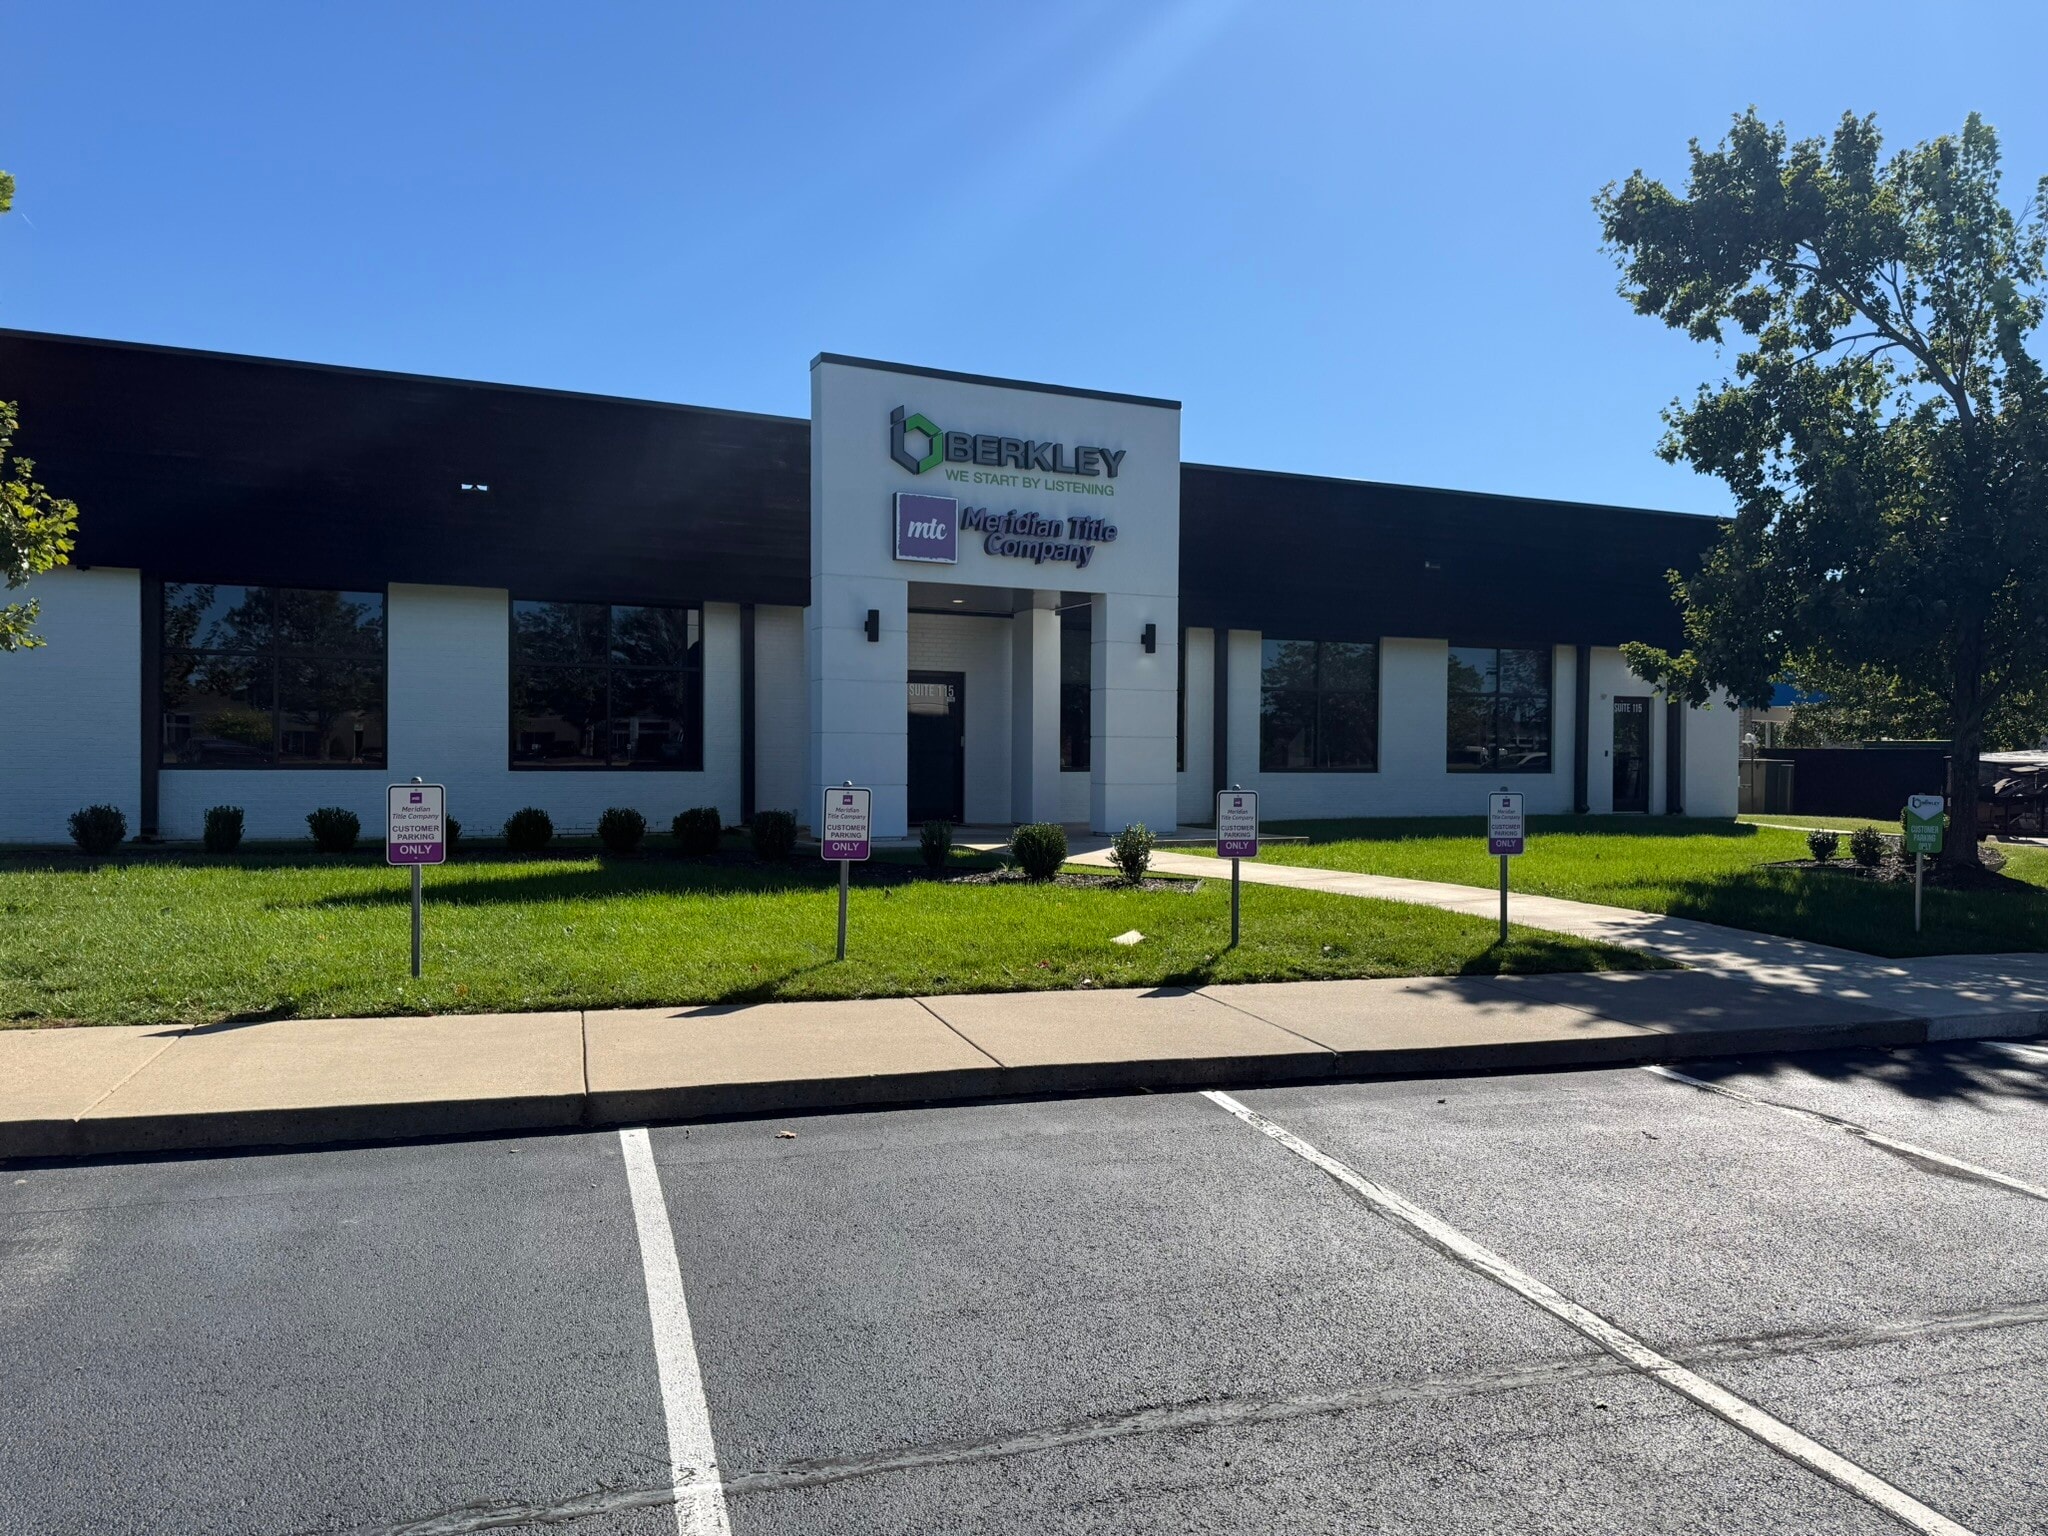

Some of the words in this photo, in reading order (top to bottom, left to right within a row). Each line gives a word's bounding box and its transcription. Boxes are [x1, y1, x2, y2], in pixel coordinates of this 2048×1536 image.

[945, 430, 1126, 478] BERKLEY
[945, 469, 969, 482] WE
[973, 473, 1017, 488] START
[1022, 476, 1041, 489] BY
[1044, 480, 1114, 496] LISTENING
[960, 506, 1063, 538] Meridian
[1067, 516, 1118, 543] Title
[907, 518, 947, 541] mtc
[984, 534, 1095, 569] Company
[909, 684, 935, 697] SUITE
[1614, 703, 1631, 712] SUITE
[1632, 704, 1642, 712] 115
[1911, 826, 1939, 834] CUSTOMER
[1913, 834, 1936, 842] PARKING
[400, 845, 432, 854] ONLY
[832, 842, 859, 851] ONLY
[1225, 842, 1249, 850] ONLY
[1919, 842, 1932, 851] ONLY
